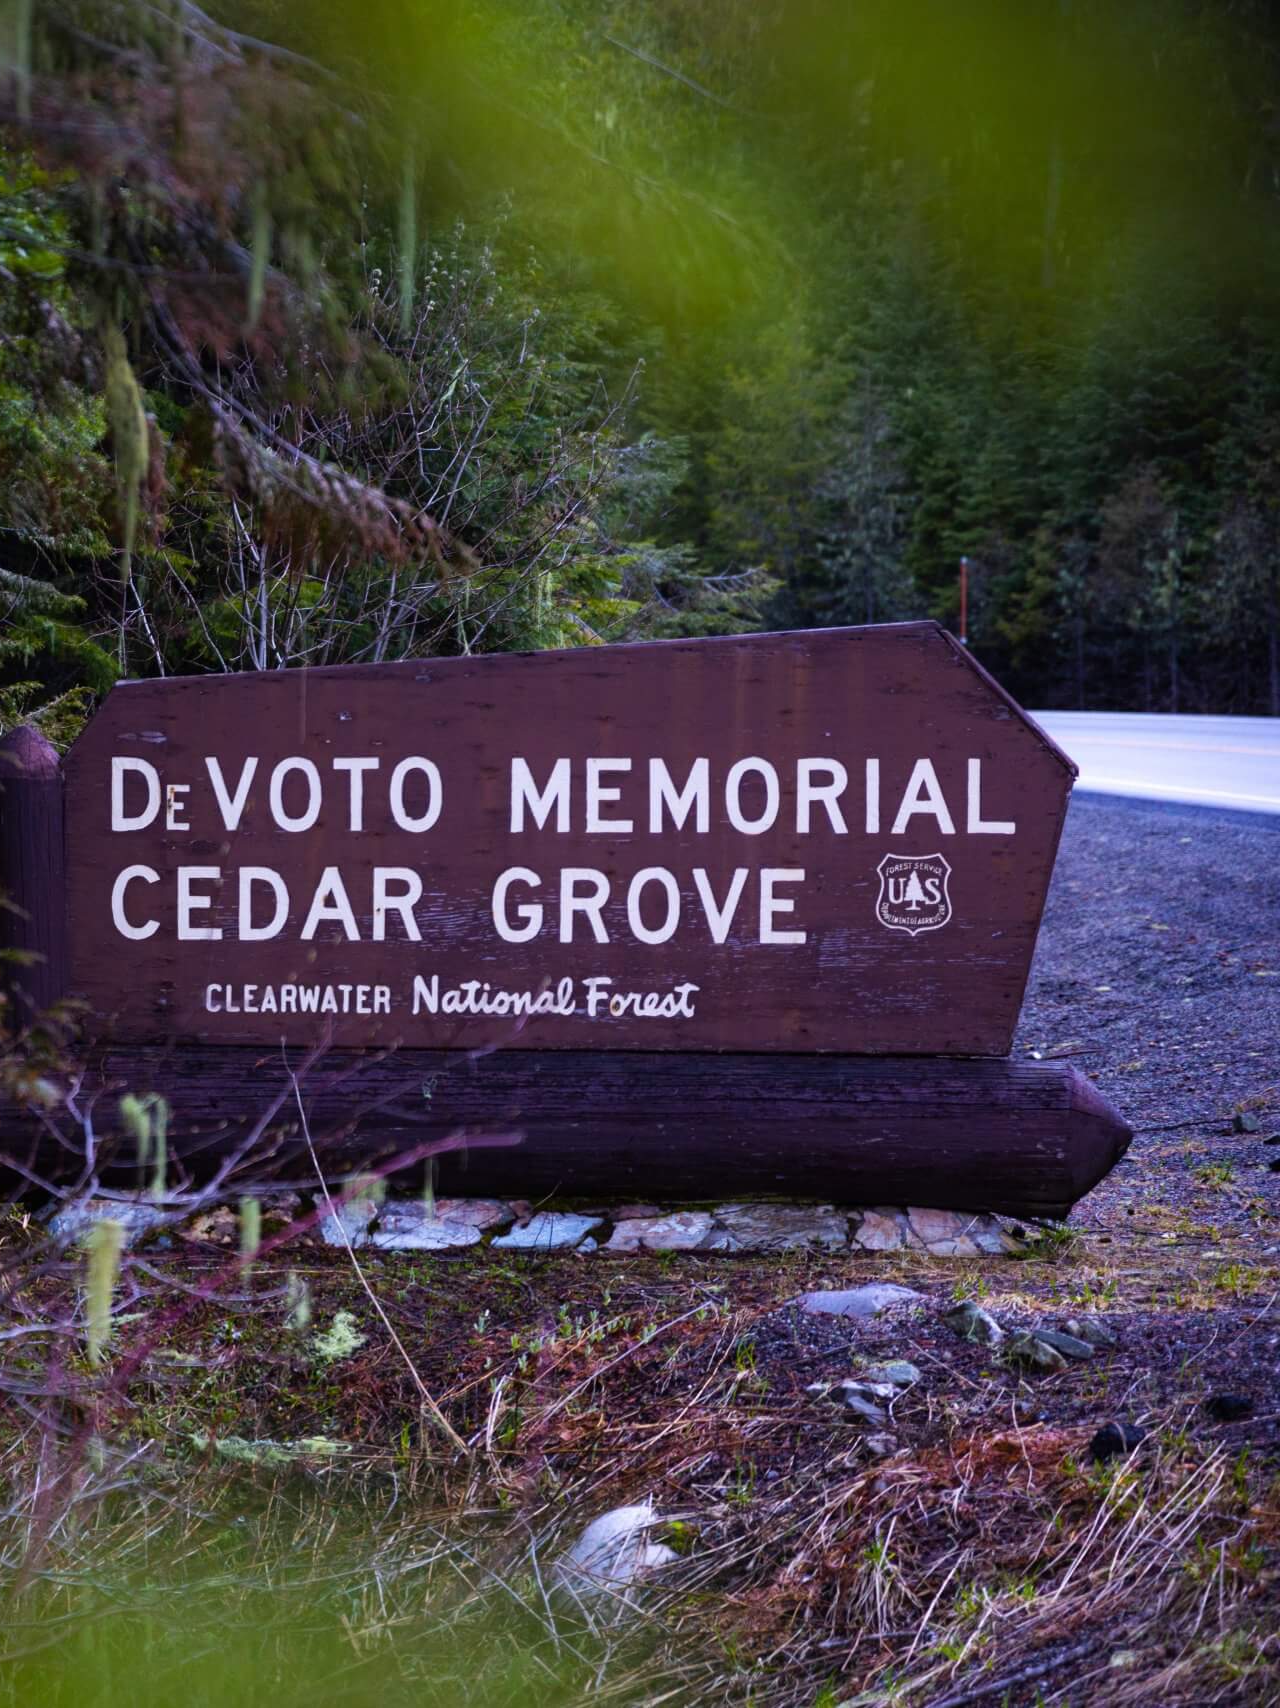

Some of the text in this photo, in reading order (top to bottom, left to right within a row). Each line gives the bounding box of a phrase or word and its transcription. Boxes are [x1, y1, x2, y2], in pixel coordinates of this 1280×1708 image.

[510, 756, 1016, 835] MEMORIAL
[885, 862, 943, 877] FOREST SERVICE
[111, 864, 807, 946] CEDAR GROVE
[205, 974, 700, 1018] CLEARWATER National Forest
